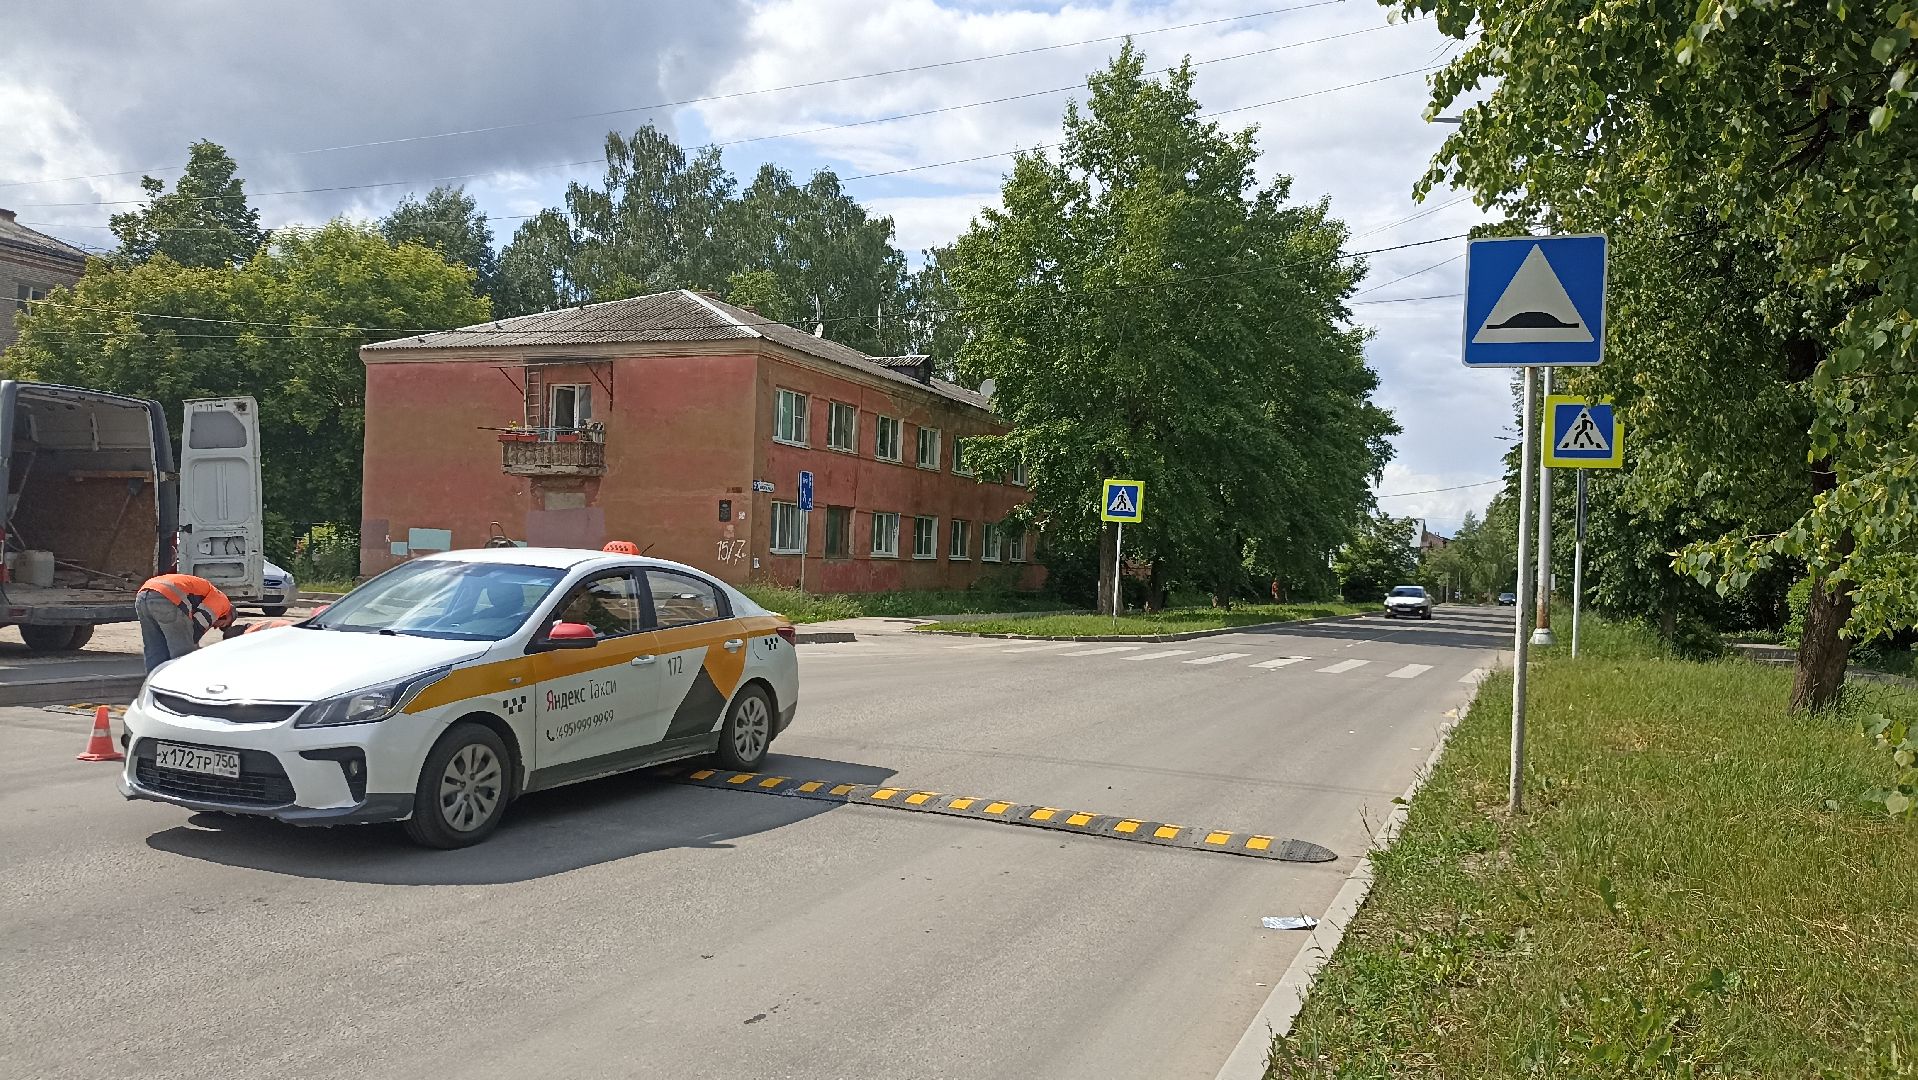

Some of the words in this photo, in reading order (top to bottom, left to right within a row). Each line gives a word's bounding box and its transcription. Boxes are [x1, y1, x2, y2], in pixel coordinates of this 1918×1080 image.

[667, 655, 683, 676] 172
[546, 687, 586, 712] Яндекс
[589, 679, 617, 700] Такси
